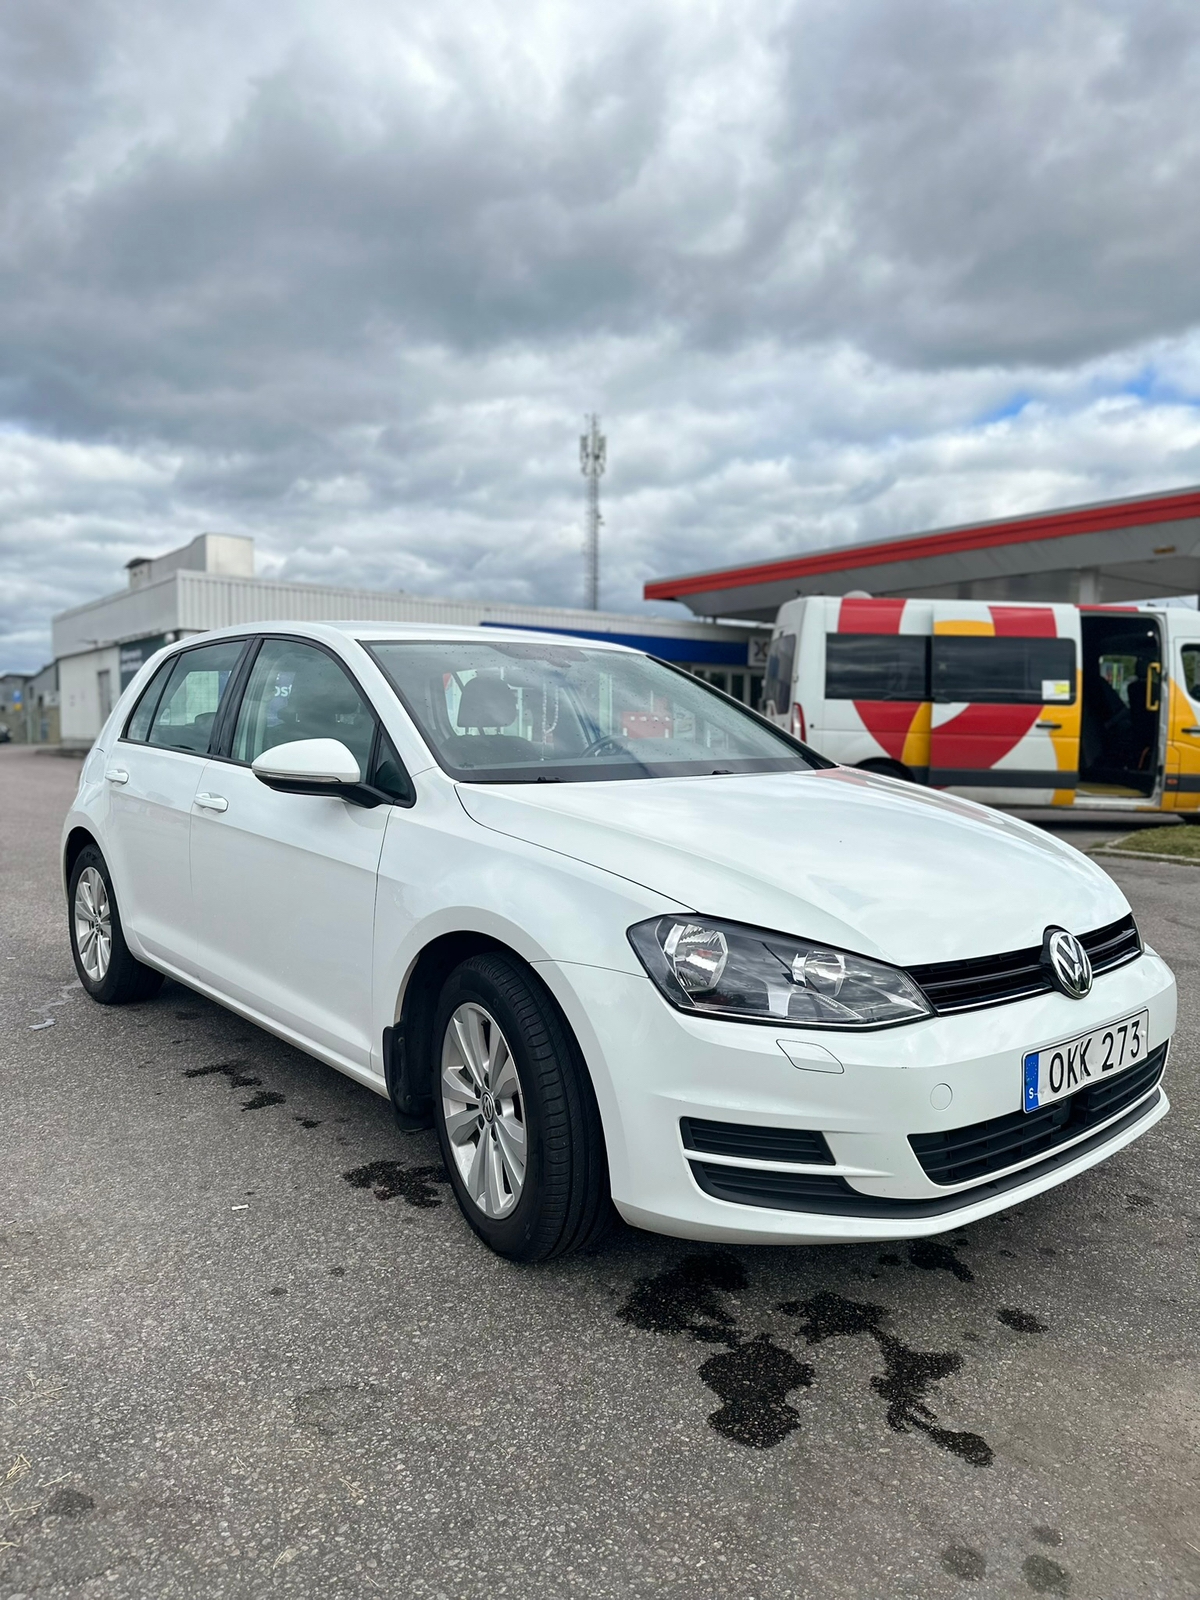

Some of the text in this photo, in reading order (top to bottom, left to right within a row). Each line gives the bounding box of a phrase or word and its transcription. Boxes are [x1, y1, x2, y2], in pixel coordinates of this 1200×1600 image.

[1049, 1019, 1140, 1094] OKK 273
[1028, 1087, 1035, 1100] S
